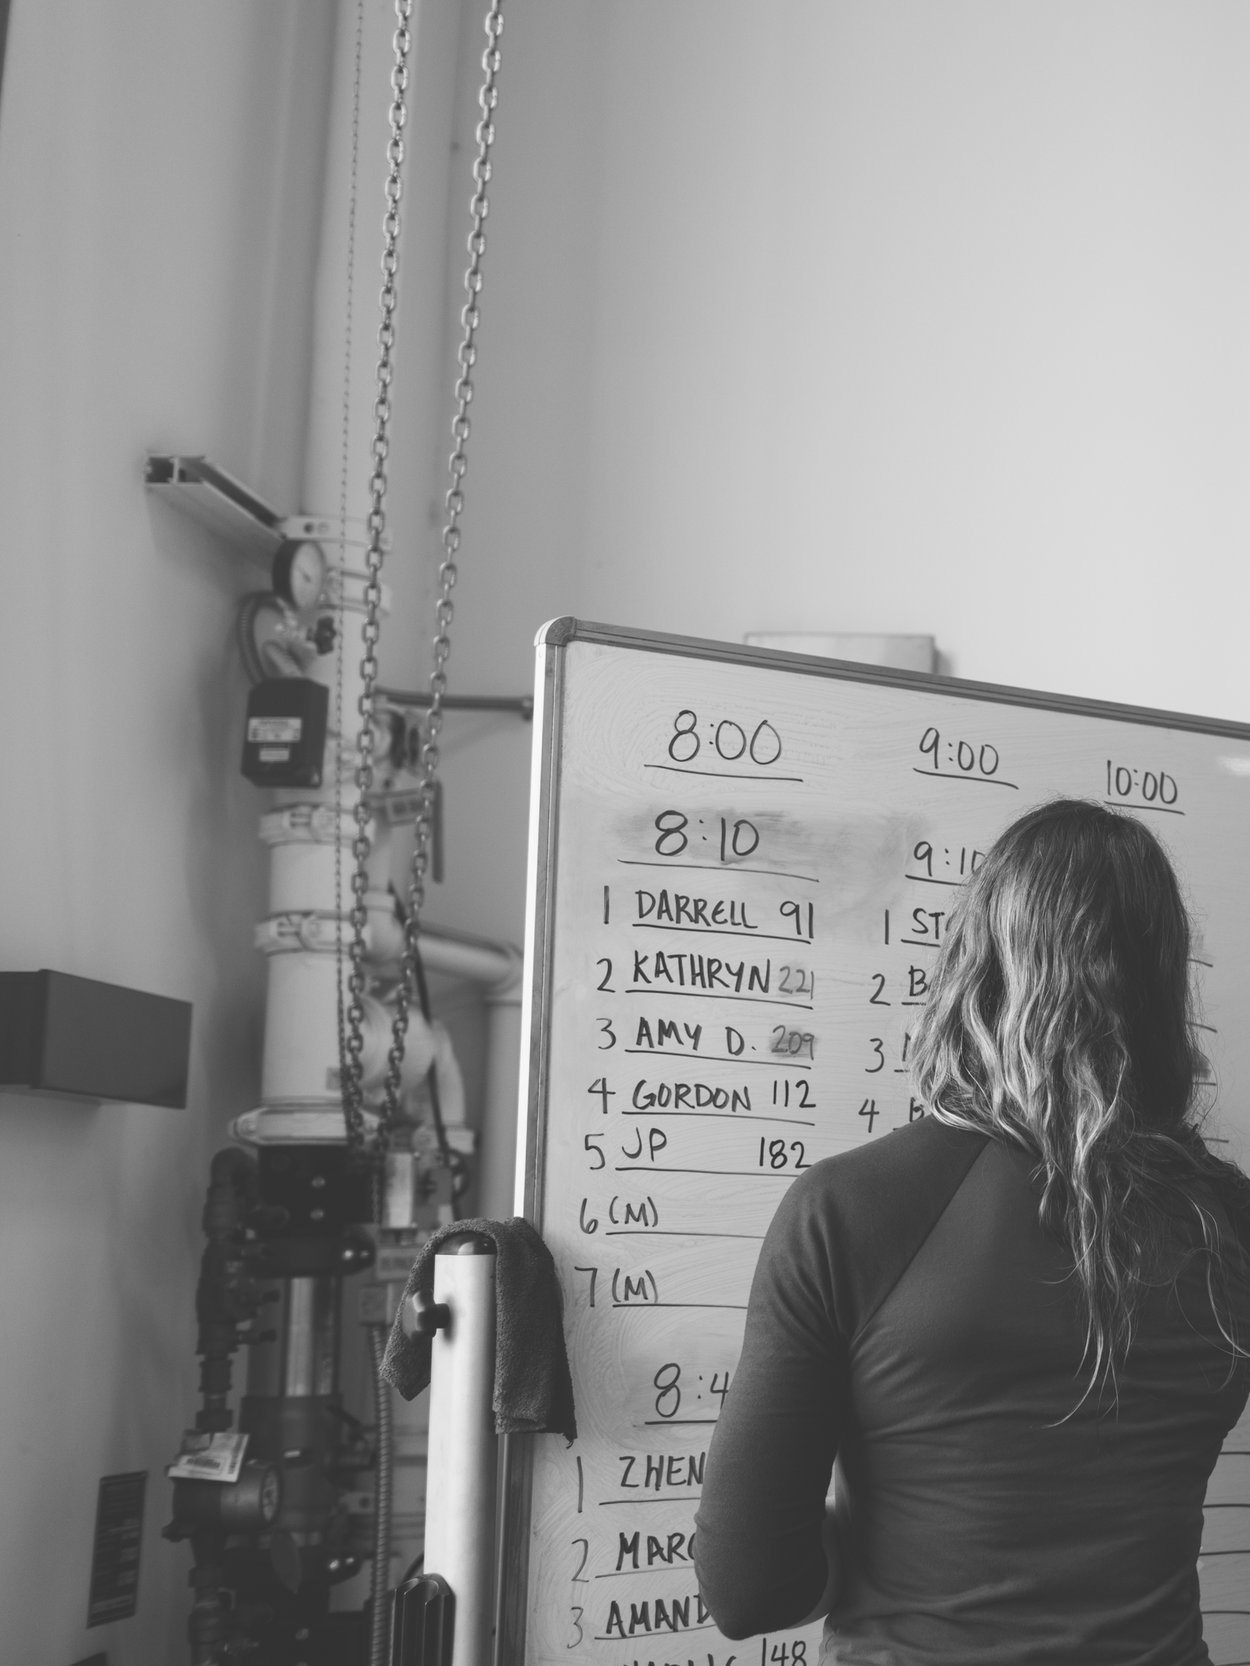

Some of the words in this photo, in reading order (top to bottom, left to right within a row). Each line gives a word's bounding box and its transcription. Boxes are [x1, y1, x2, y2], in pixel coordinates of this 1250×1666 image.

[668, 709, 782, 765] 8:00
[918, 727, 999, 775] 9:00
[1106, 759, 1178, 804] 10:00
[654, 809, 760, 862] 8:10
[634, 889, 759, 929] DARRELL
[779, 900, 815, 939] 91
[596, 958, 616, 993] 2
[632, 950, 771, 994] KATHRYN
[777, 966, 815, 1000] 221
[869, 973, 892, 1006] 2
[595, 1017, 617, 1050] 3
[635, 1016, 703, 1051] AMY
[725, 1026, 757, 1056] D.
[771, 1024, 815, 1061] 209
[864, 1037, 885, 1074] 3
[587, 1077, 617, 1115] 4
[631, 1079, 752, 1113] GORDON
[772, 1079, 817, 1109] 112
[857, 1098, 881, 1134] 4
[584, 1132, 606, 1171] 5
[621, 1126, 668, 1163] JP
[758, 1136, 813, 1169] 182
[579, 1197, 599, 1235] 6
[608, 1195, 659, 1228] (M)
[574, 1265, 598, 1308] 7
[611, 1267, 659, 1304] (M)
[570, 1538, 590, 1583] 2
[566, 1606, 584, 1649] 3
